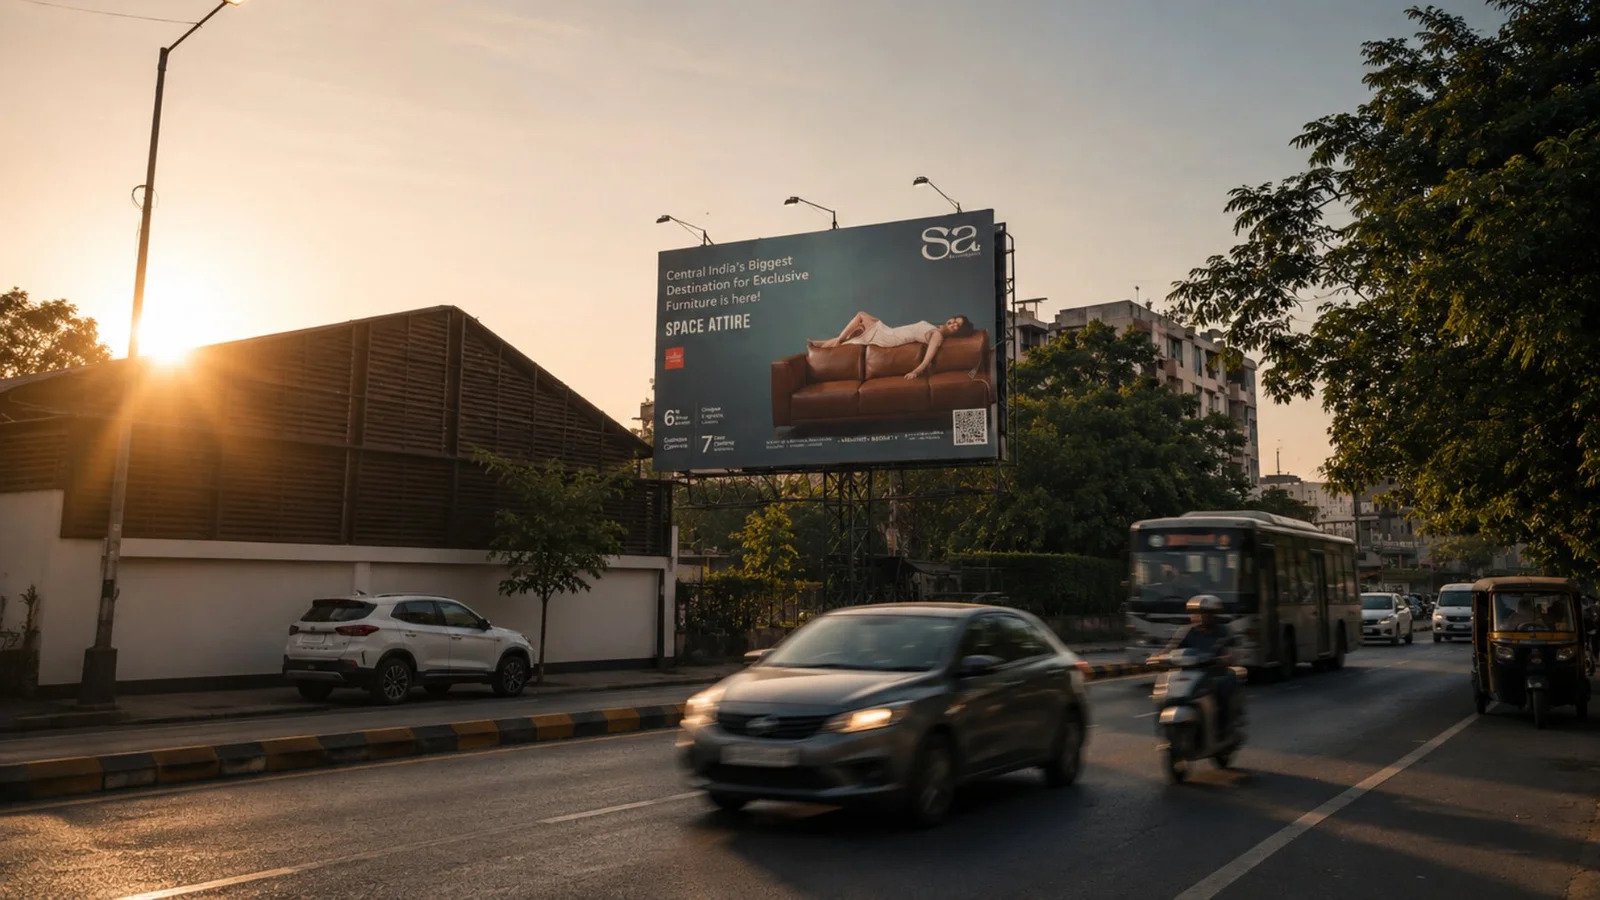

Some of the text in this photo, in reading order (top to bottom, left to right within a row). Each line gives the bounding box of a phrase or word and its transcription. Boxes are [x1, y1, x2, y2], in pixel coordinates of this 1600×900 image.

[666, 255, 794, 281] Central India's Biggest
[666, 270, 809, 296] Destination for Exclusive
[666, 291, 761, 311] Furniture is here!
[665, 313, 751, 337] SPACE ATTIRE
[664, 409, 675, 426] 6
[701, 434, 713, 453] 7
